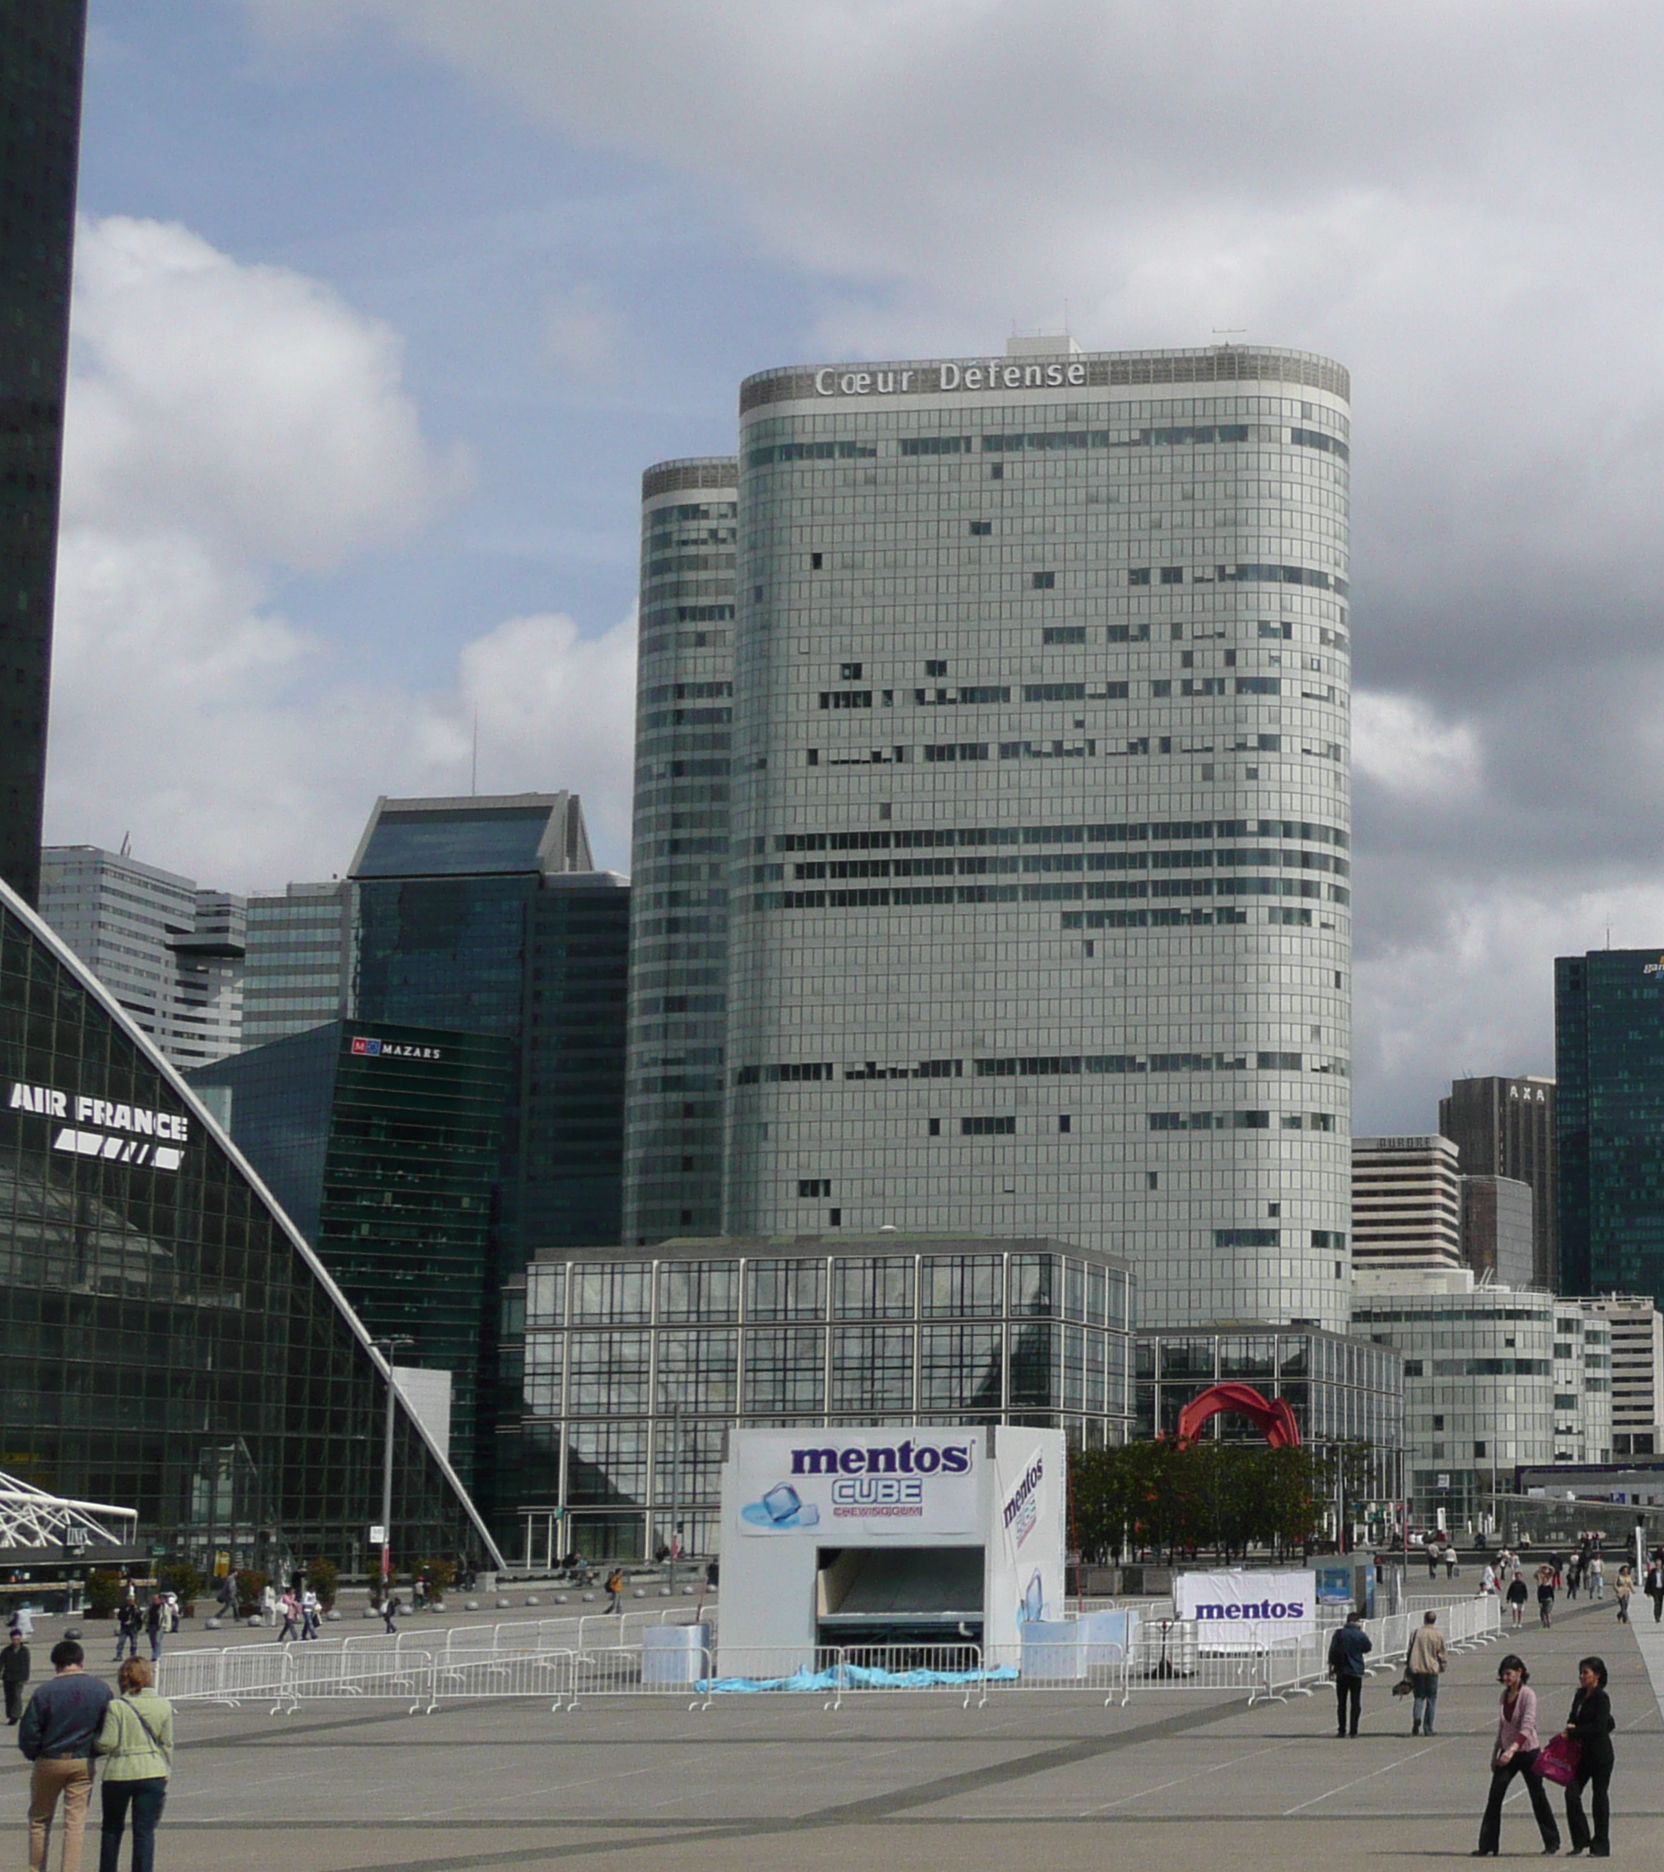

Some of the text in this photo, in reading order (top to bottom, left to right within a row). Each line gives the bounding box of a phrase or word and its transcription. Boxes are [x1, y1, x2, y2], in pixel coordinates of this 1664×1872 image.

[814, 366, 914, 396] Cœur
[381, 1043, 442, 1059] MAZARS
[9, 1082, 189, 1142] AIR FRANCE
[790, 1437, 970, 1474] mentos
[831, 1477, 923, 1505] CUBE
[1003, 1457, 1043, 1529] mentos
[833, 1506, 923, 1517] CHEWING GUM
[1195, 1598, 1304, 1619] mentos
